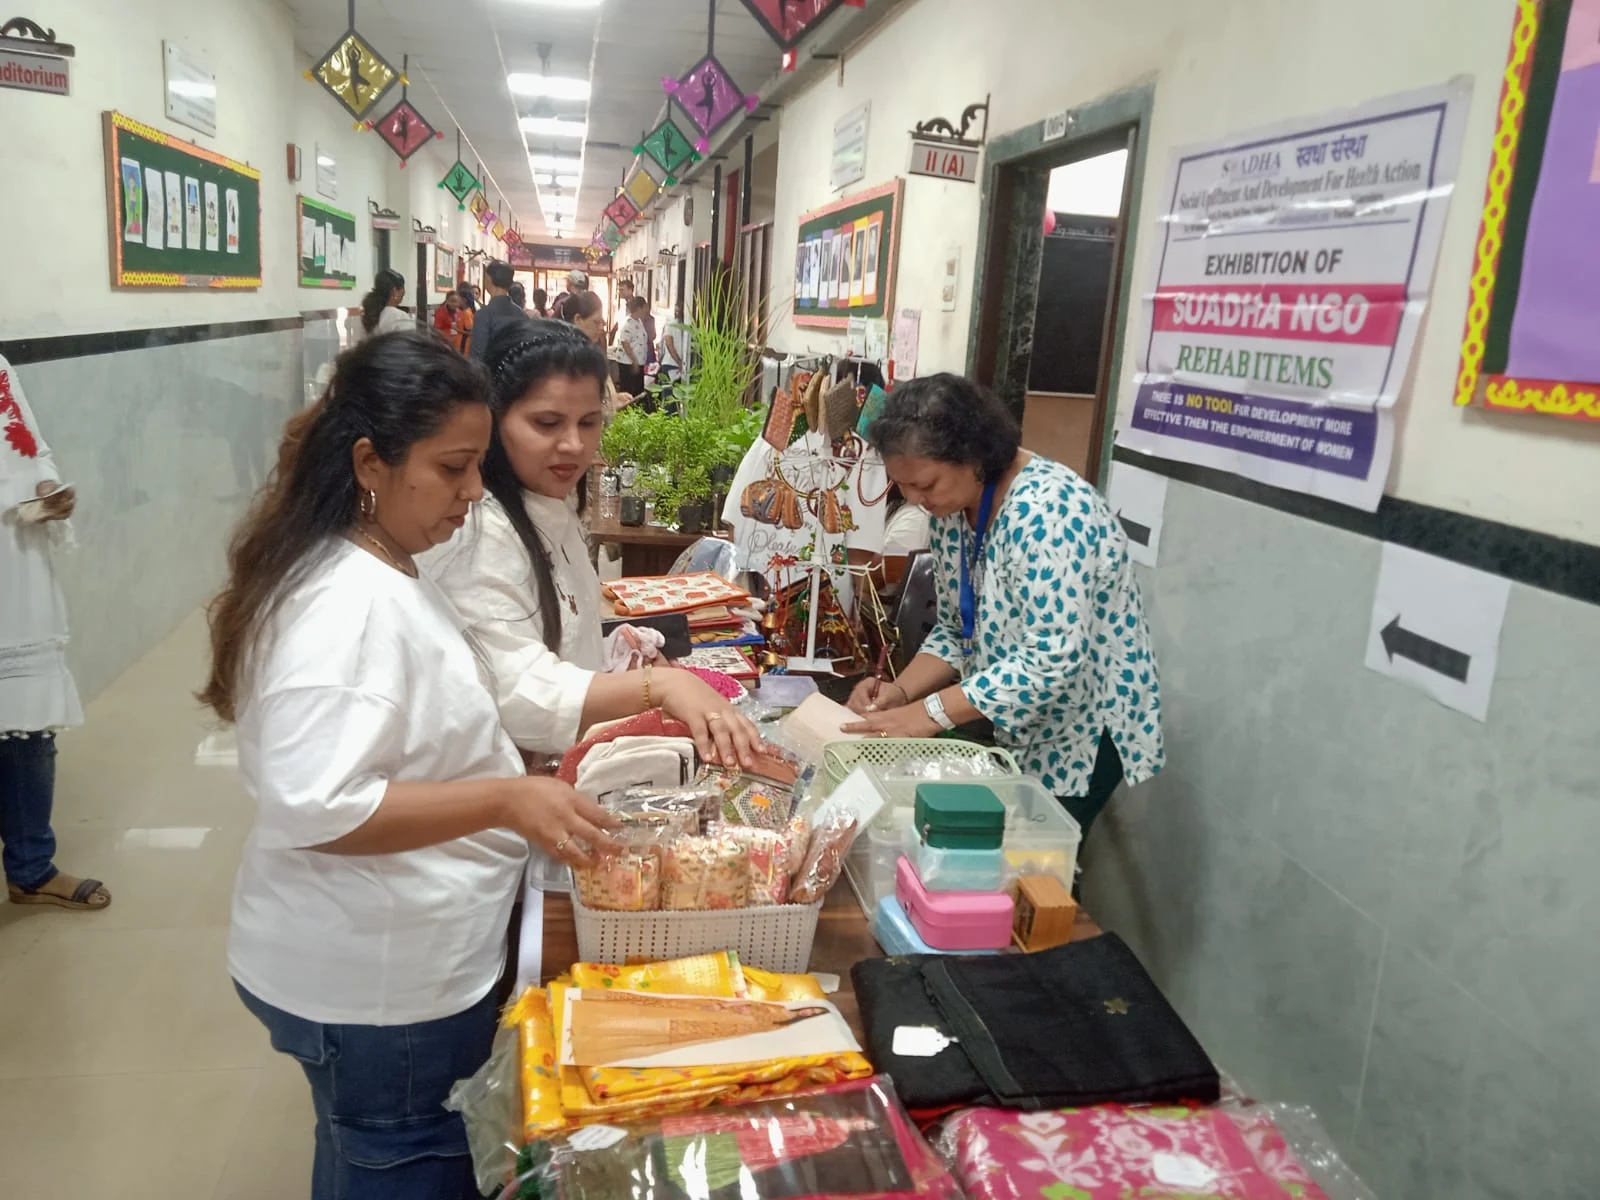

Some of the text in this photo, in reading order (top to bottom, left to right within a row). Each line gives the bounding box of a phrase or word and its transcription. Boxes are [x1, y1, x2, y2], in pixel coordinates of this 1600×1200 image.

[941, 152, 964, 177] (A)
[1383, 159, 1421, 183] Action
[1204, 248, 1344, 276] EXHIBITION OF
[1172, 290, 1371, 335] SUADHA NGO
[1173, 393, 1184, 406] IS
[1185, 393, 1204, 409] NO
[1233, 403, 1251, 417] FOR
[1250, 405, 1324, 429] DEVELOPMENT
[1324, 418, 1353, 436] MORE
[1143, 408, 1183, 426] EFFECTIVE
[1183, 415, 1209, 430] THEN
[1210, 420, 1230, 435] THE
[1301, 438, 1316, 452] OF
[1315, 441, 1355, 461] WOMEN
